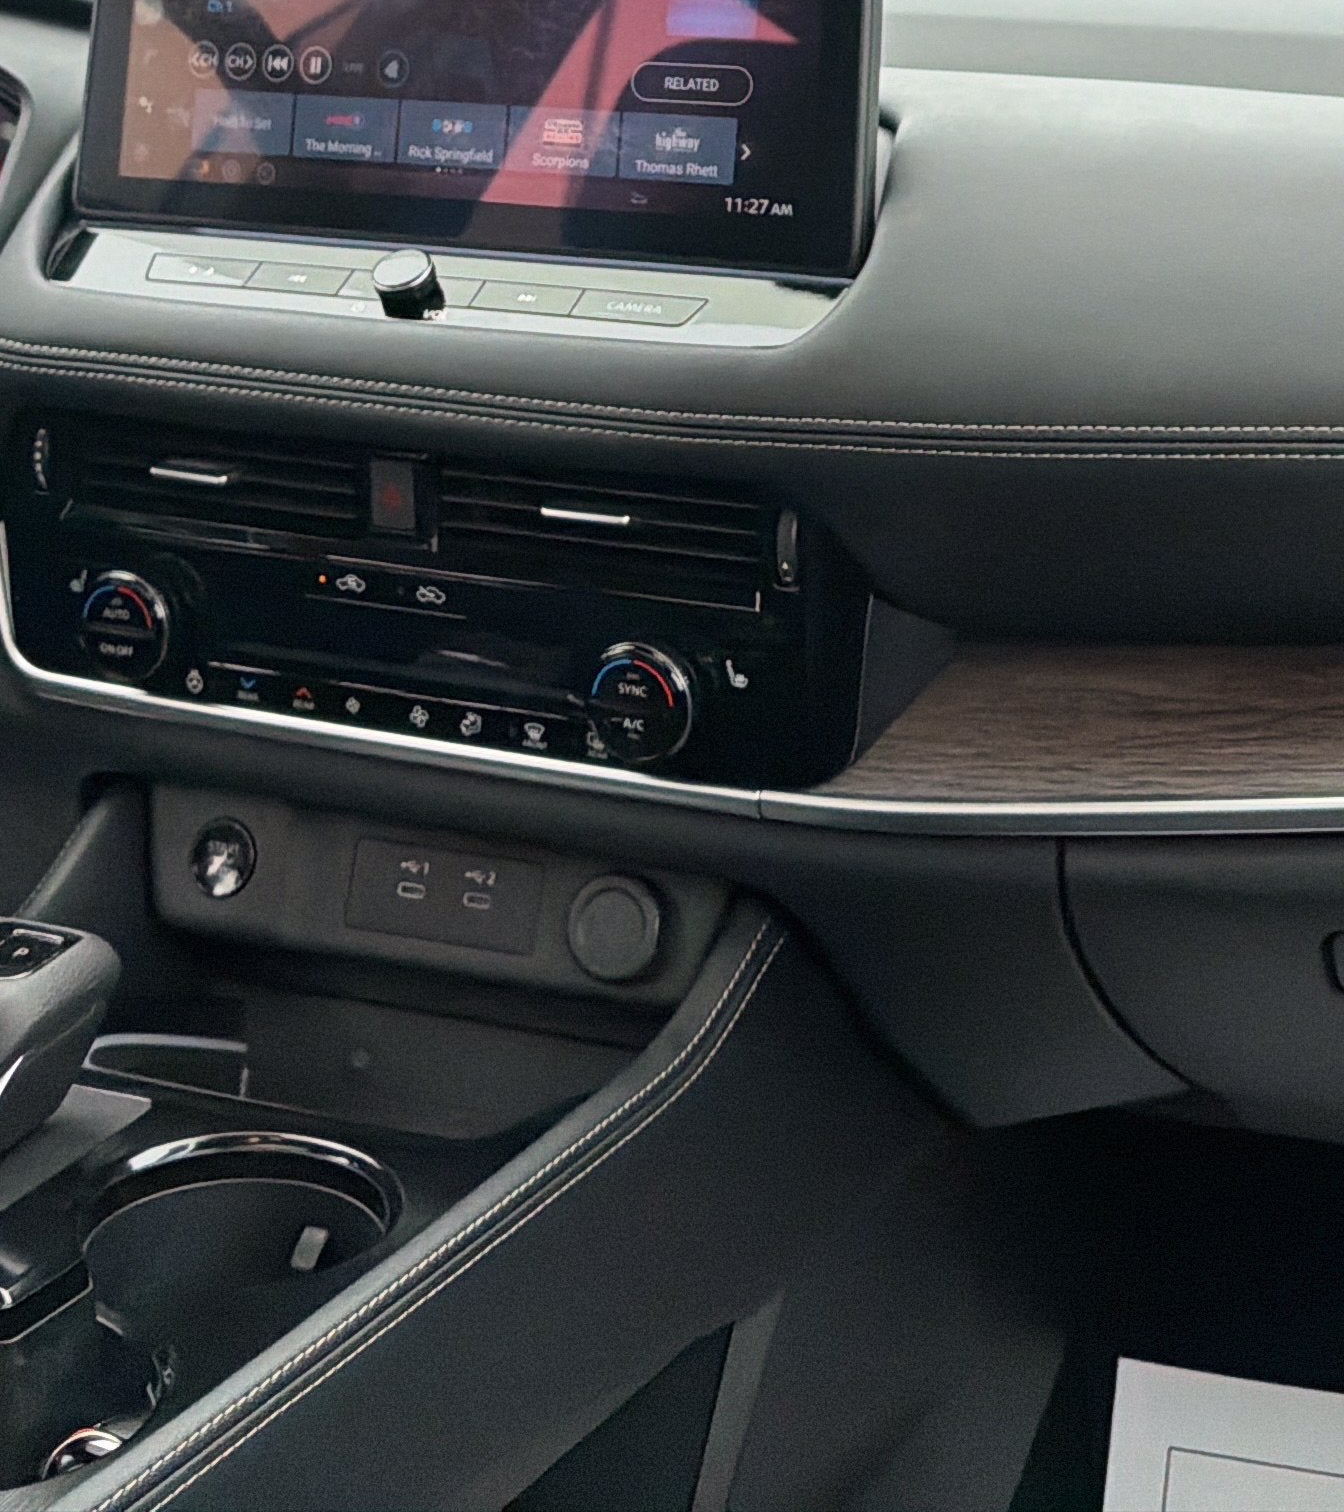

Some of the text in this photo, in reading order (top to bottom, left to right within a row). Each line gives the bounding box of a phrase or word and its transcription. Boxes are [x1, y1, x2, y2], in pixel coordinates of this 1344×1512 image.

[664, 76, 720, 93] RELATED
[305, 138, 323, 153] The
[326, 139, 372, 157] Morning
[655, 132, 701, 153] highway
[408, 144, 494, 165] Rick Springfield
[531, 153, 590, 171] Scorpions
[635, 159, 718, 178] Thomas Rhett
[724, 195, 794, 218] 11:27 AM
[606, 300, 662, 315] CAMERA
[102, 606, 131, 621] AUTO
[617, 682, 648, 698] SYNC
[623, 717, 645, 733] A/C
[12, 946, 30, 959] P
